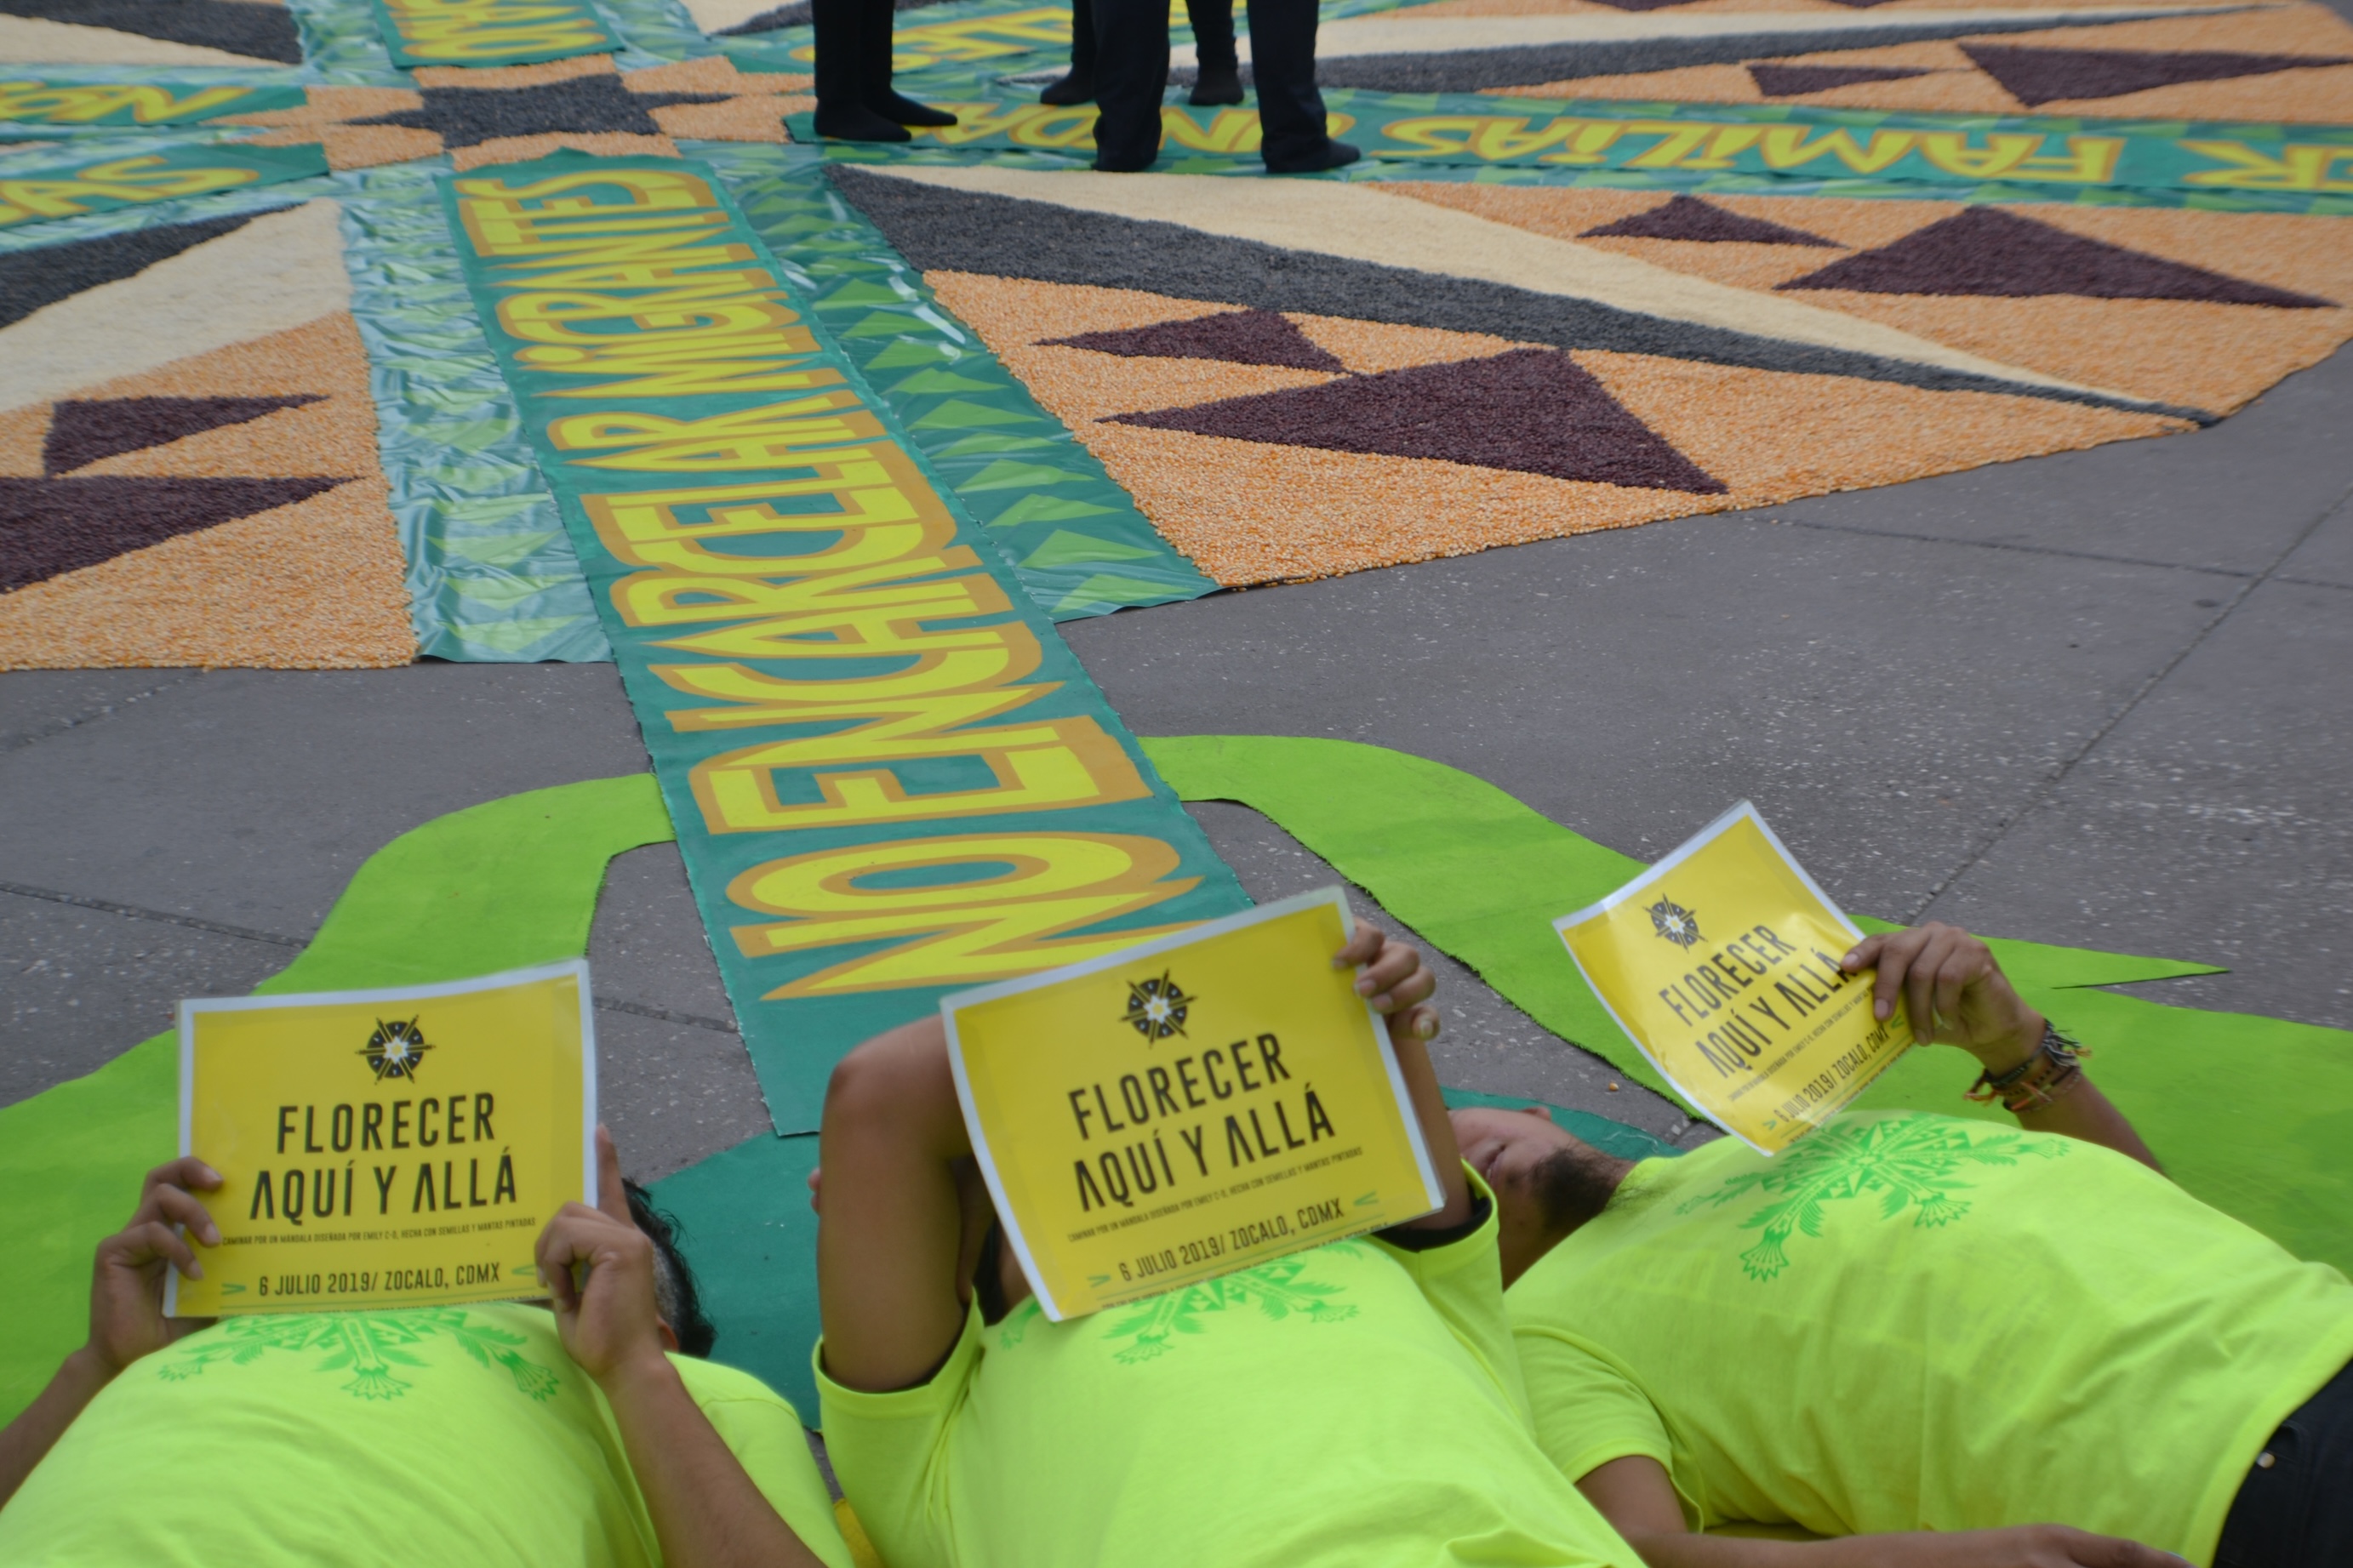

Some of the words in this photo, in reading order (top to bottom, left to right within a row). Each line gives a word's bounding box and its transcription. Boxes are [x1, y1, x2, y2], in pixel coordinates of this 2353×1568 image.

[546, 388, 1155, 835] ENCARCELAR
[726, 831, 1246, 1000] NO
[1658, 925, 1796, 1028] FLORECER
[1694, 1009, 1773, 1079] AQUÍ
[1750, 997, 1791, 1030] Y
[277, 1092, 495, 1155] FLORECER
[1067, 1031, 1292, 1141] FLORECER
[1774, 1109, 1790, 1122] 6
[1781, 1094, 1811, 1119] JULIO
[248, 1159, 356, 1227] AQUÍ
[374, 1165, 397, 1215] Y
[412, 1145, 517, 1214] ALLÁ
[1073, 1128, 1175, 1212] AQUÍ
[1179, 1125, 1209, 1177] Y
[1225, 1082, 1335, 1168] ALLÁ
[1265, 1167, 1297, 1185] SEMILLAS
[1305, 1156, 1330, 1172] MANTAS
[1331, 1147, 1363, 1164] PINTADAS
[348, 1231, 361, 1241] POR
[363, 1231, 383, 1240] EMILY
[402, 1228, 421, 1239] HECHA
[425, 1227, 436, 1237] CON
[438, 1224, 470, 1235] SEMILLAS
[471, 1223, 477, 1233] Y
[477, 1220, 503, 1232] MANTAS
[505, 1217, 536, 1229] PINTADAS
[1118, 1262, 1131, 1282] 6
[1136, 1248, 1178, 1279] JULIO
[1229, 1216, 1296, 1252] ZOCALO,
[1297, 1197, 1345, 1230] CDMX
[260, 1276, 268, 1296] 6
[275, 1274, 320, 1295] JULIO
[384, 1268, 448, 1291] ZOCALO,
[456, 1262, 500, 1286] CDMX
